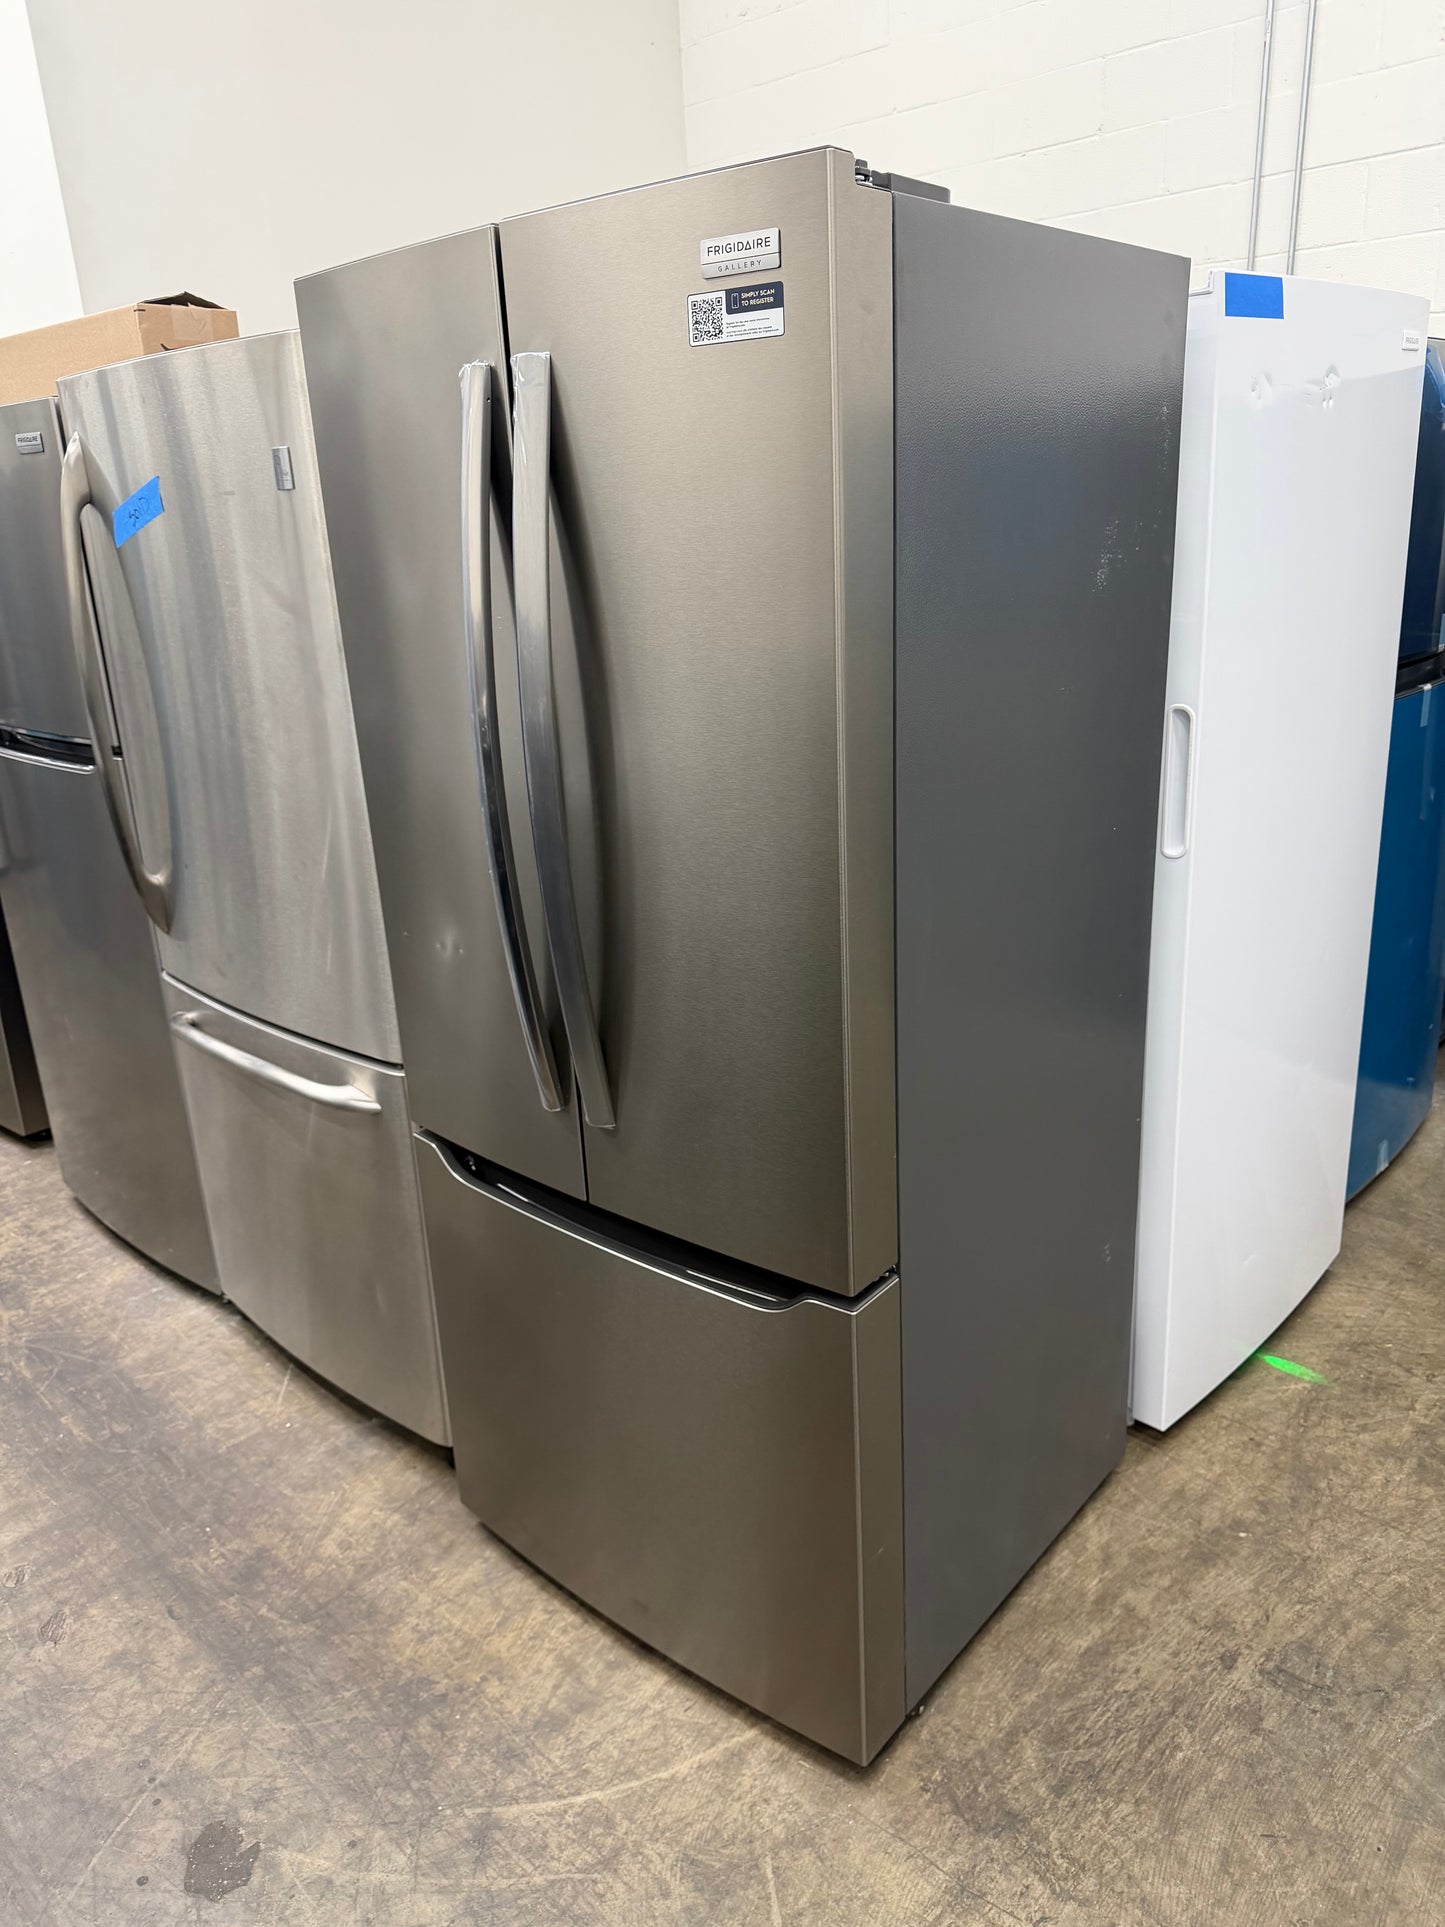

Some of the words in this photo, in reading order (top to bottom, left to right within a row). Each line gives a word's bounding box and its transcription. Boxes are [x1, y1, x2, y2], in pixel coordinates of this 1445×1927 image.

[707, 236, 771, 257] FRIGIDAIRE
[717, 259, 762, 273] GALLERY
[741, 290, 759, 299] SIMPLY
[760, 288, 775, 297] SCAN
[750, 297, 774, 306] REGISTER
